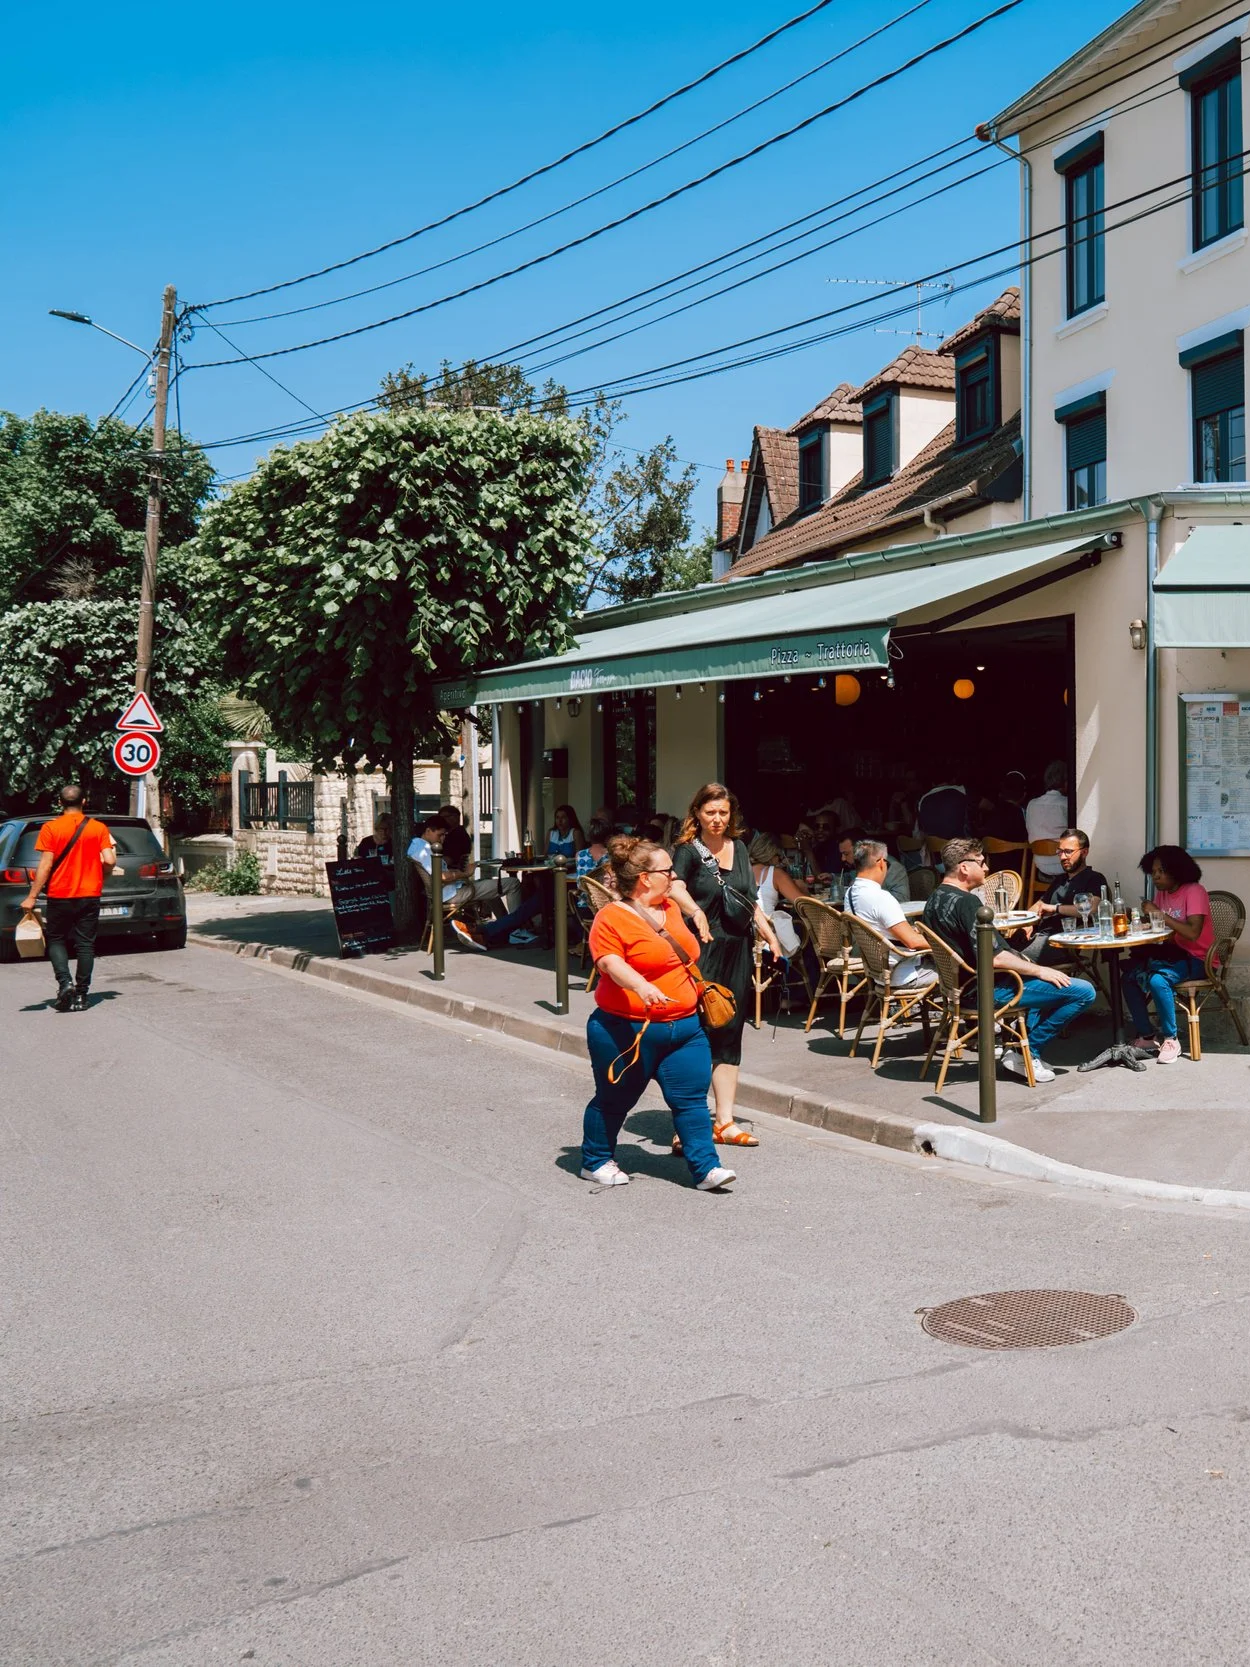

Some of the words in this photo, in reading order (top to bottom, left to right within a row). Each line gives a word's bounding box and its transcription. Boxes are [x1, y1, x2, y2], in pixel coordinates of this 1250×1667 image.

[770, 648, 799, 665] Pizza
[817, 640, 870, 661] Trattoria
[123, 744, 150, 763] 30
